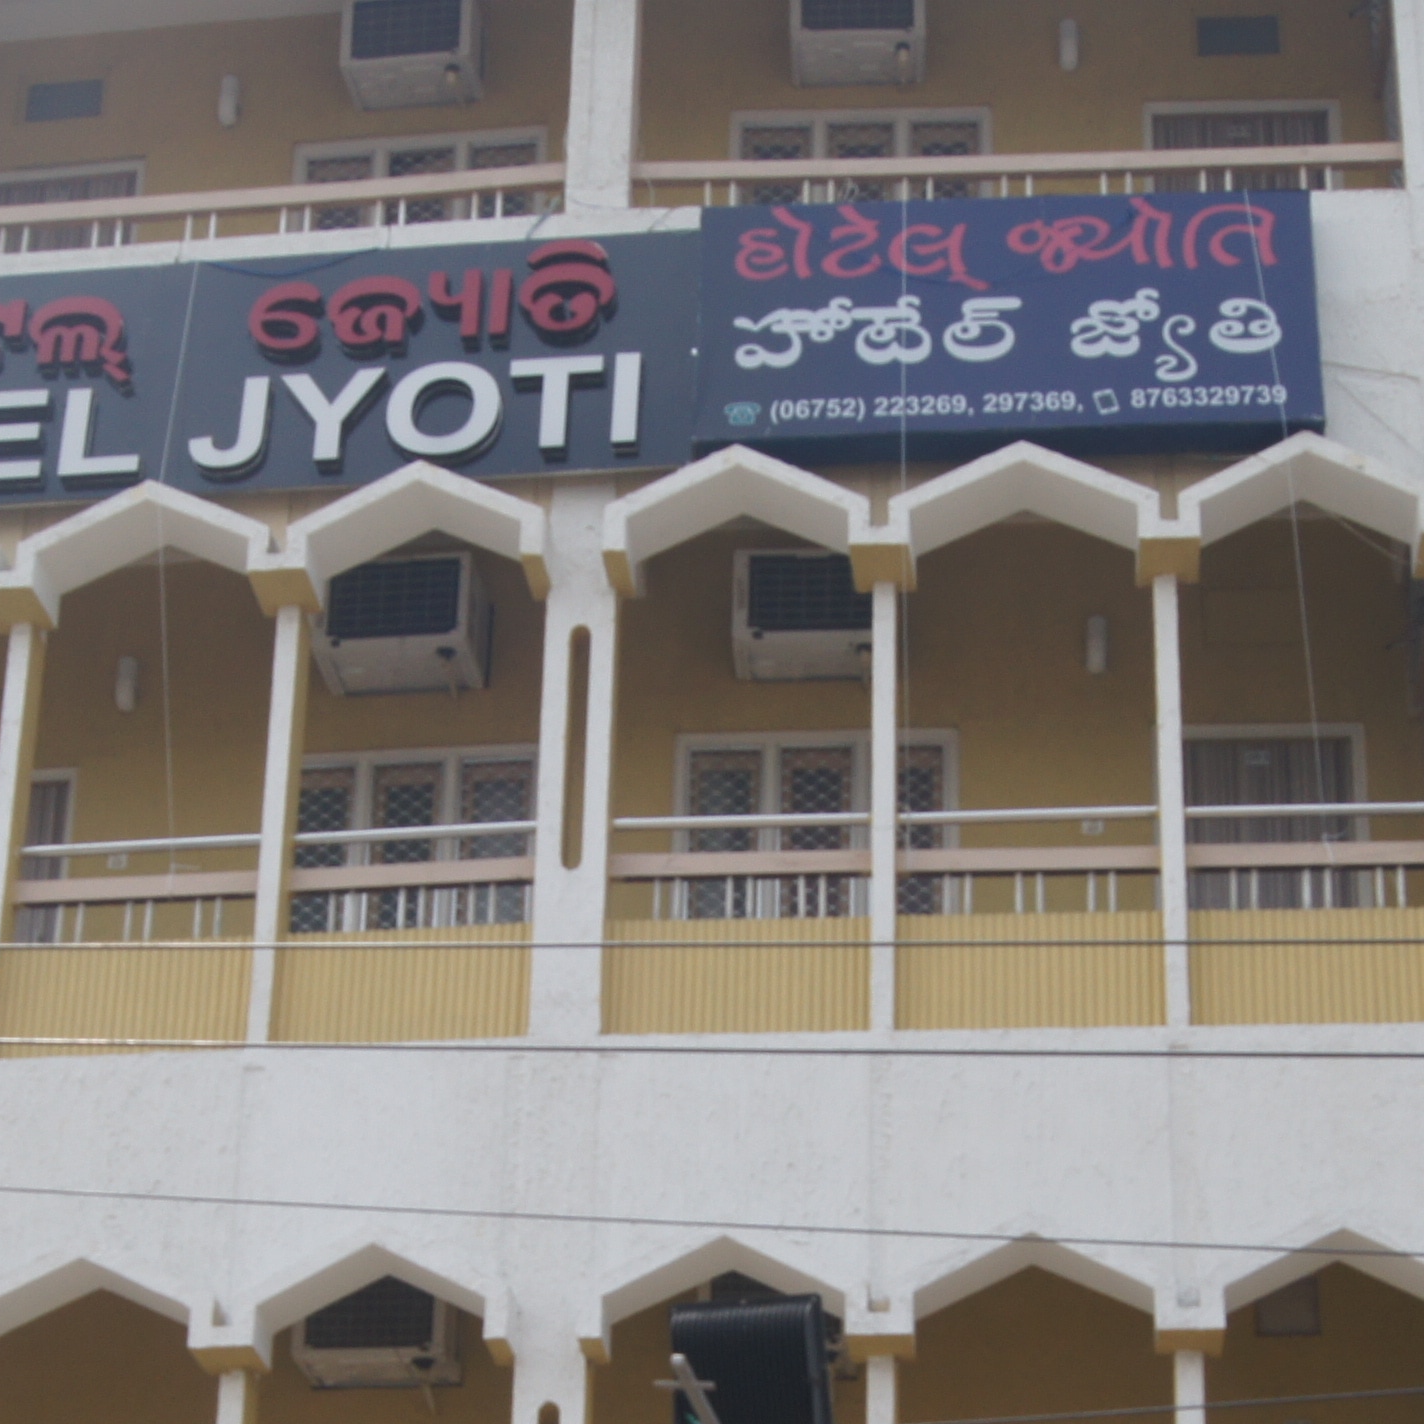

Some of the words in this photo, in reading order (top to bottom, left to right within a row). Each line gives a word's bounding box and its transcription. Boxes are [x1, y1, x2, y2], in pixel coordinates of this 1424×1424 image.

[1006, 196, 1279, 274] જ્યોતિ
[1070, 287, 1282, 382] జ్యోతి
[188, 351, 642, 471] JYOTI
[770, 399, 866, 422] (06752)
[873, 394, 975, 417] 223269,
[982, 391, 1083, 414] 297369,
[1130, 384, 1288, 408] 8763329739
